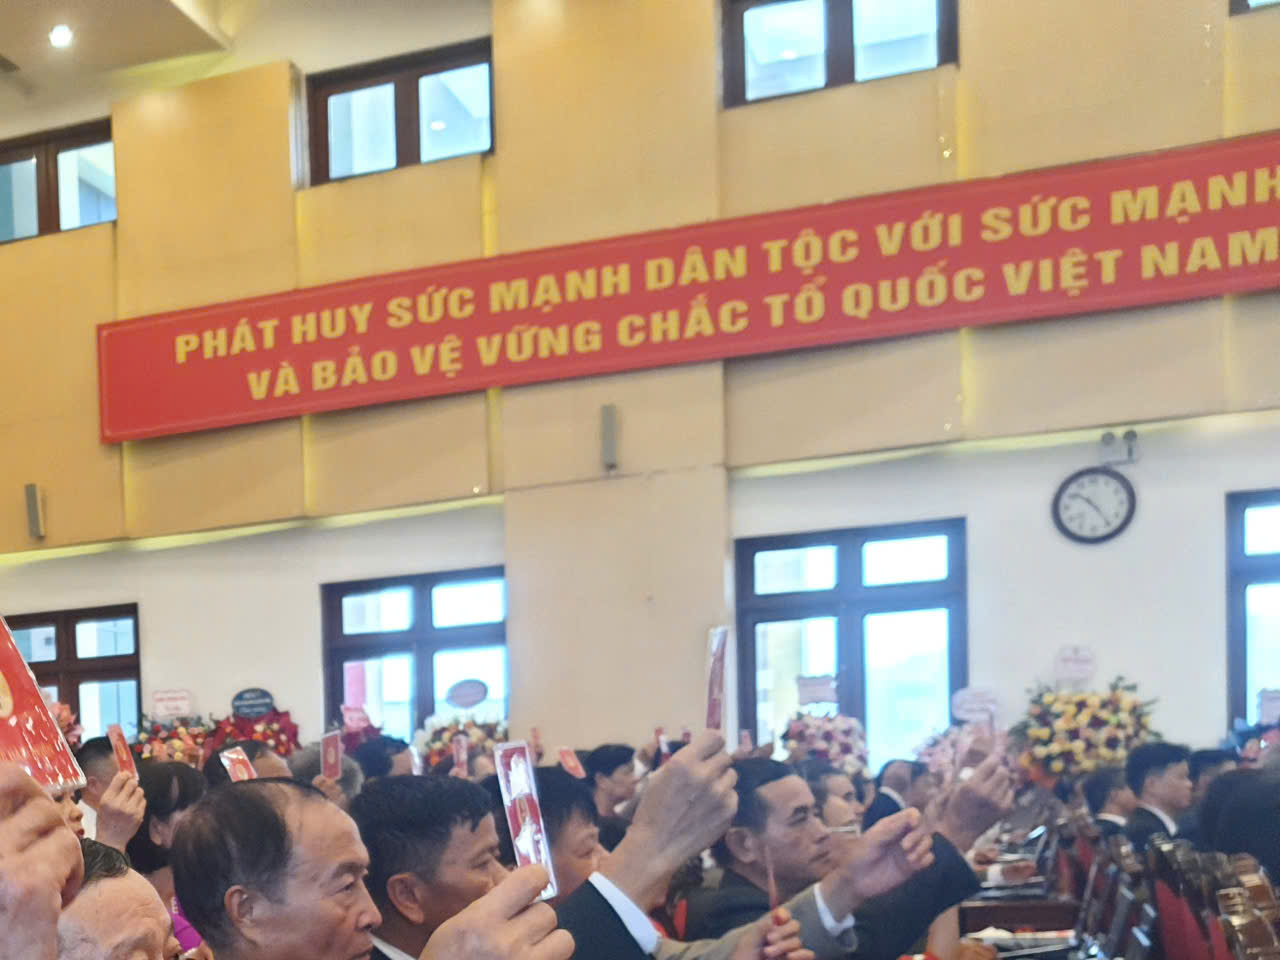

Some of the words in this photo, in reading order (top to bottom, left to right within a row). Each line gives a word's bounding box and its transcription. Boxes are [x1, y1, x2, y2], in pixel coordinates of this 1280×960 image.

[176, 318, 278, 363] PHÁT
[292, 303, 372, 344] HUY
[388, 287, 474, 328] SỨC
[490, 264, 630, 312] MẠNH
[646, 246, 746, 290] DÂN
[763, 229, 858, 274] TỘC
[876, 211, 962, 256] VỚI
[981, 196, 1090, 241] SỨC
[1111, 166, 1280, 224] MẠNH
[248, 362, 299, 400] VÀ
[312, 346, 397, 390] BẢO
[411, 335, 461, 377] VỆ
[477, 321, 602, 365] VỮNG
[618, 295, 748, 346] CHẮC
[764, 277, 825, 326] TỔ
[842, 261, 984, 319] QUỐC
[1003, 248, 1122, 296] VIỆT
[1141, 227, 1279, 278] NAM
